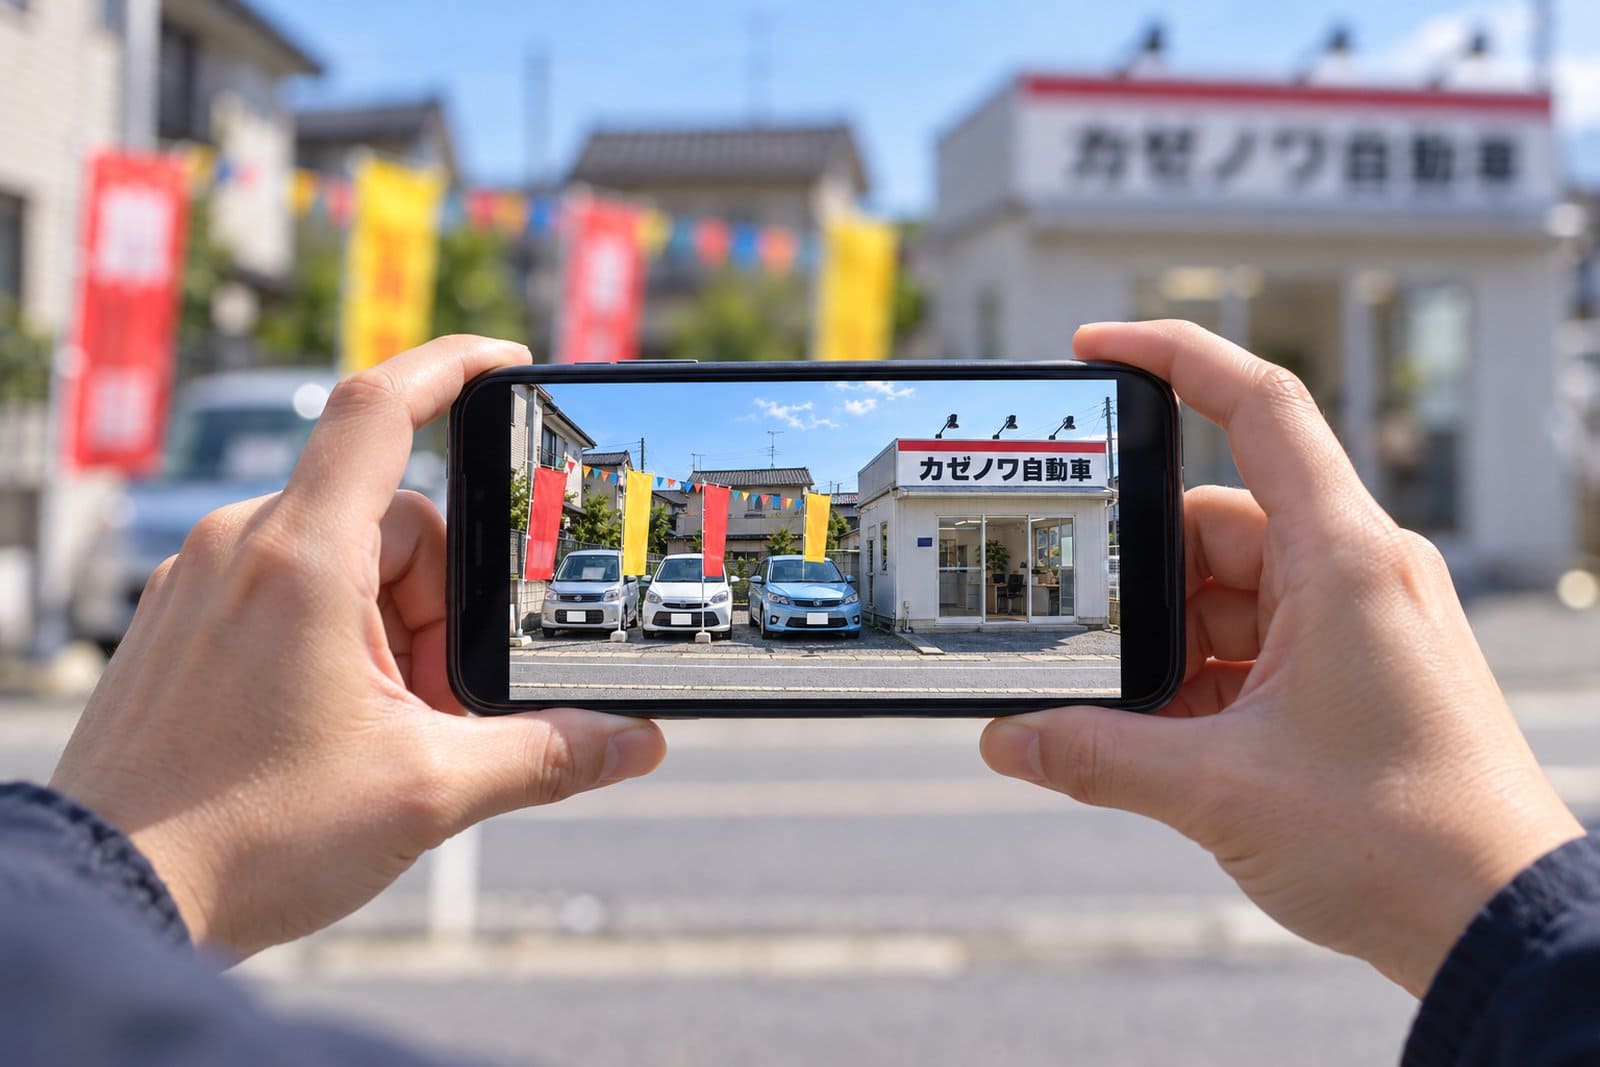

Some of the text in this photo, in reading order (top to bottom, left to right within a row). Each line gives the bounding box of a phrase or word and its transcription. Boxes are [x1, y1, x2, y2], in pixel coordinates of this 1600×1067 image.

[919, 455, 1092, 483] カゼノワ自動車
